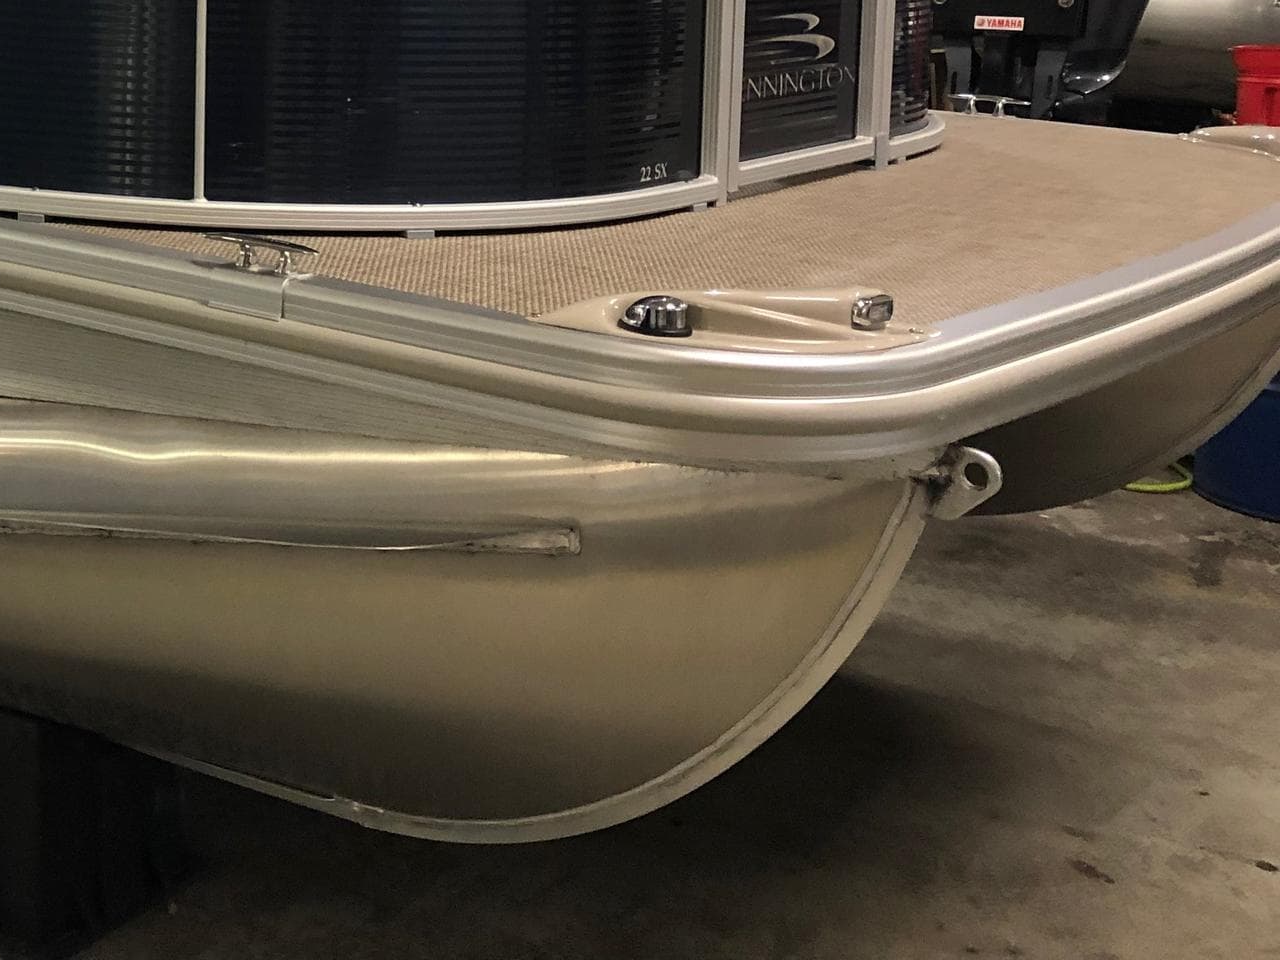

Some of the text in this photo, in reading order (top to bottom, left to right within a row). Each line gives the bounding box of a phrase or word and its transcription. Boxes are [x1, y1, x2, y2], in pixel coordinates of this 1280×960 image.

[987, 17, 1023, 30] YAMAHA
[742, 65, 856, 101] NNINGTON
[640, 161, 668, 183] 22 SX
